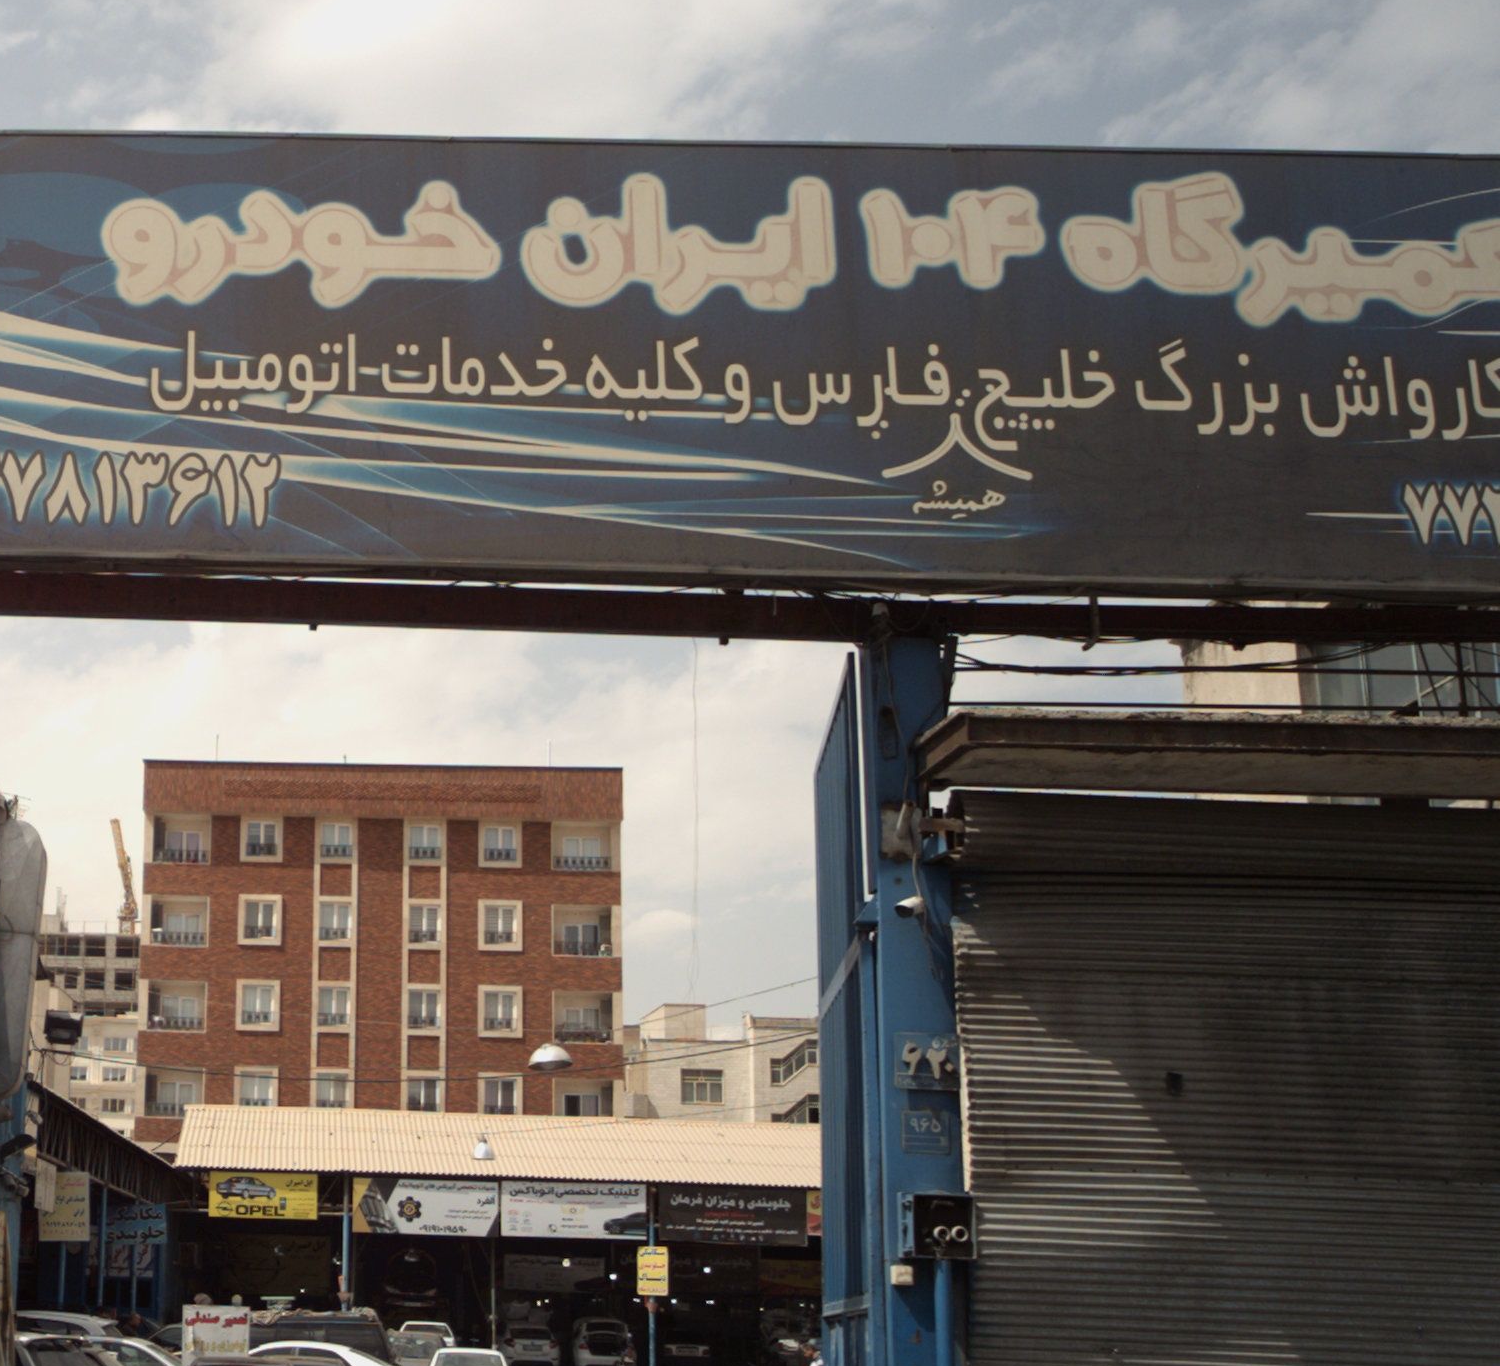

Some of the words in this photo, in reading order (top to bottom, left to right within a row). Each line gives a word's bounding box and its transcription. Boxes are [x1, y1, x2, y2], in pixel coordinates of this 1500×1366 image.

[103, 180, 502, 306] خودرو
[522, 173, 836, 315] ایران
[150, 329, 357, 415] اتومبیل
[380, 338, 568, 401] خدمات
[585, 336, 700, 423] کلیه
[772, 343, 951, 439] فارس
[973, 348, 1117, 451] خلیج
[1136, 338, 1279, 437] بزرگ
[911, 480, 1006, 520] همیشه
[235, 1204, 285, 1216] OPEL
